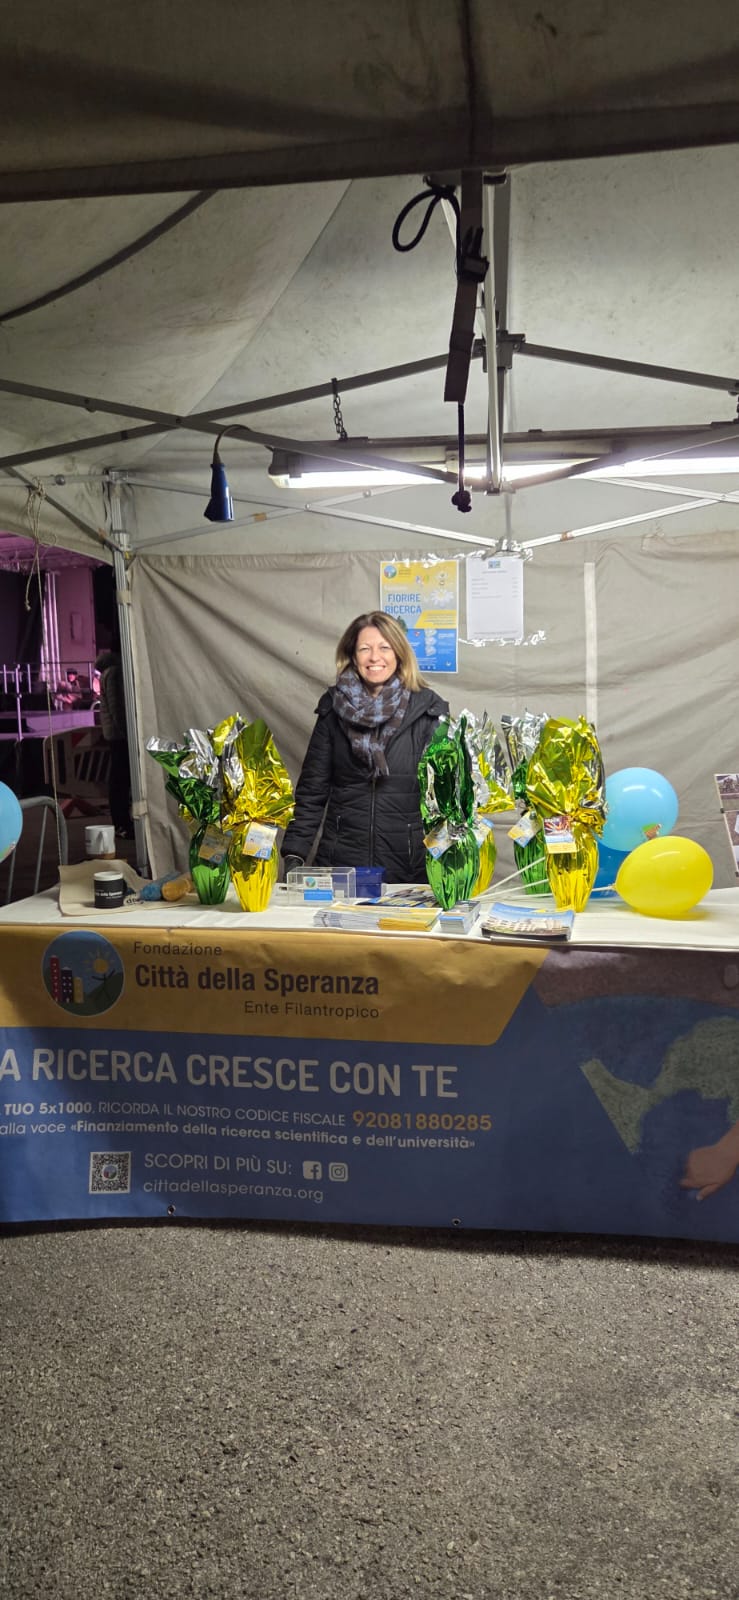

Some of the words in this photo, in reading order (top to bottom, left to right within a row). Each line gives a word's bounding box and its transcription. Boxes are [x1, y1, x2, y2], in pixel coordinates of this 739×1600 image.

[384, 604, 422, 614] RICERCA
[388, 593, 421, 603] FIORIRE
[133, 941, 223, 956] Fondazione
[135, 964, 188, 989] Città
[198, 966, 256, 991] della
[264, 968, 379, 996] Speranza
[244, 1000, 279, 1015] Ente
[285, 1001, 380, 1020] Filantropico
[32, 1048, 177, 1084] RICERCA
[186, 1054, 319, 1092] CRESCE
[329, 1061, 400, 1096] CON
[411, 1065, 458, 1098] TE
[4, 1102, 34, 1116] TUO
[98, 1102, 159, 1115] RICORDA
[163, 1104, 175, 1116] IL
[177, 1105, 231, 1119] NOSTRO
[234, 1108, 289, 1123] CODICE
[293, 1111, 346, 1127] FISCALE
[352, 1110, 493, 1131] 92081880285
[0, 1121, 26, 1135] alla
[31, 1121, 66, 1134] voce
[71, 1119, 179, 1134] «Finanziamento
[183, 1122, 217, 1136] della
[221, 1125, 271, 1139] ricerca
[275, 1128, 348, 1145] scientifica
[352, 1135, 362, 1145] e
[144, 1153, 208, 1169] SCOPRI
[214, 1155, 231, 1171] DI
[236, 1154, 262, 1173] PIÙ
[266, 1158, 293, 1176] SU:
[143, 1178, 324, 1204] cittadellasperanza.org
